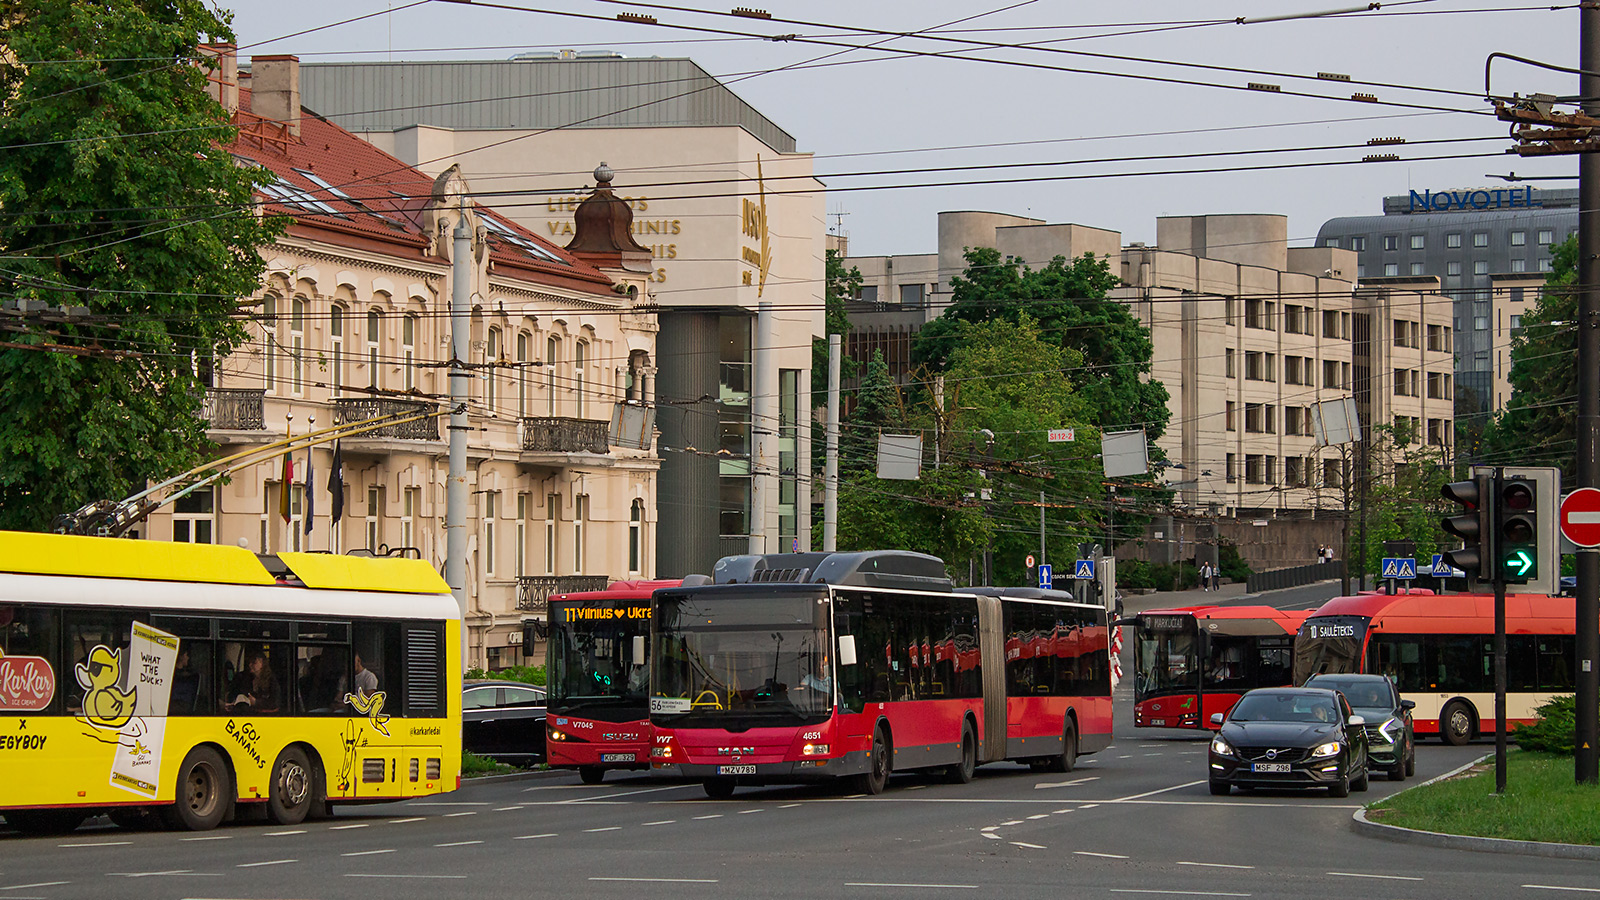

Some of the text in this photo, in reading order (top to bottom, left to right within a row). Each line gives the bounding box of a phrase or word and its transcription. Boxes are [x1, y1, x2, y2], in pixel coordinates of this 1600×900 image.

[1409, 185, 1543, 211] NOVOTEL
[577, 608, 613, 619] Vilnius
[140, 651, 161, 665] WHAT
[143, 664, 159, 676] THE
[0, 661, 52, 699] KarKar
[140, 673, 163, 686] DUCK?
[651, 700, 662, 711] 56
[242, 722, 260, 744] GO!
[602, 733, 639, 741] ISUZU
[803, 732, 821, 740] 4651
[225, 719, 266, 769] BANANAS
[718, 747, 755, 756] MAN
